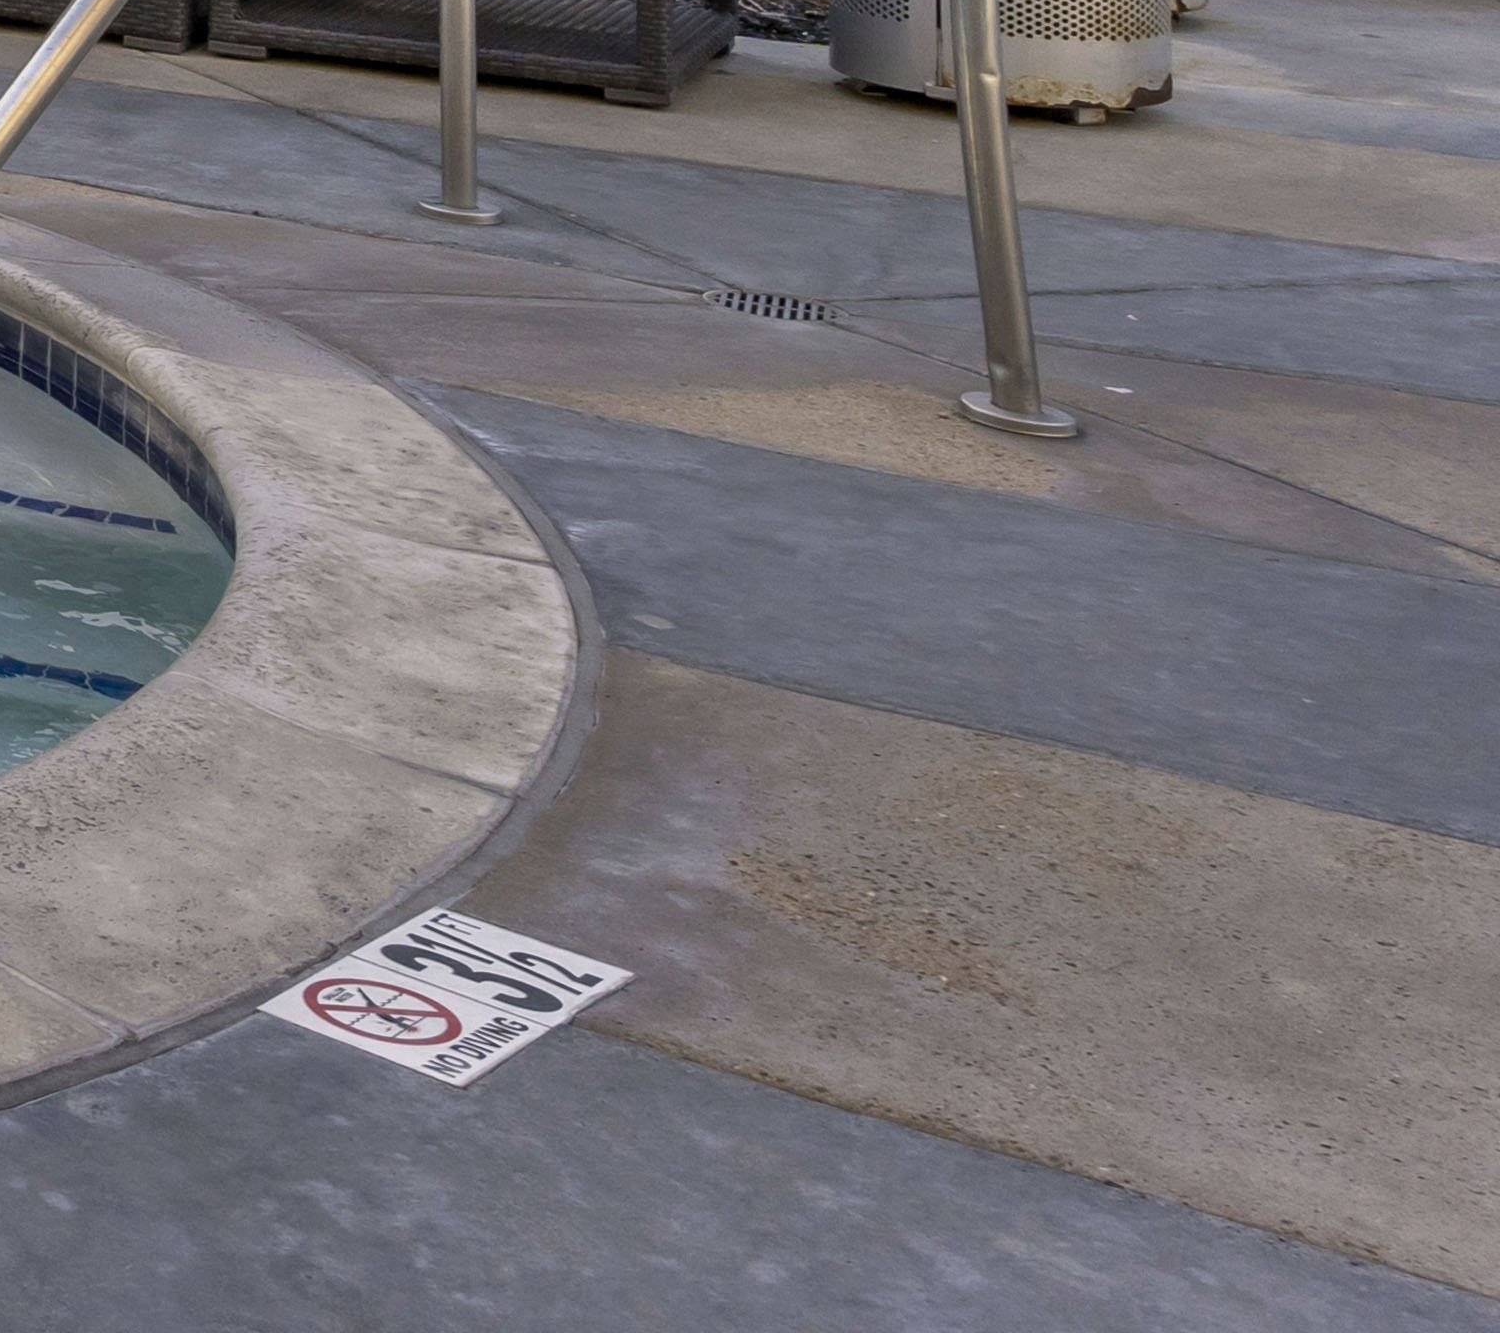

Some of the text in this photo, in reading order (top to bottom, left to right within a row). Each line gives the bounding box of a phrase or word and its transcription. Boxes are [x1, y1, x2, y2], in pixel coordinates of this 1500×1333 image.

[429, 912, 483, 936] FT
[421, 1015, 531, 1079] NO DIVING
